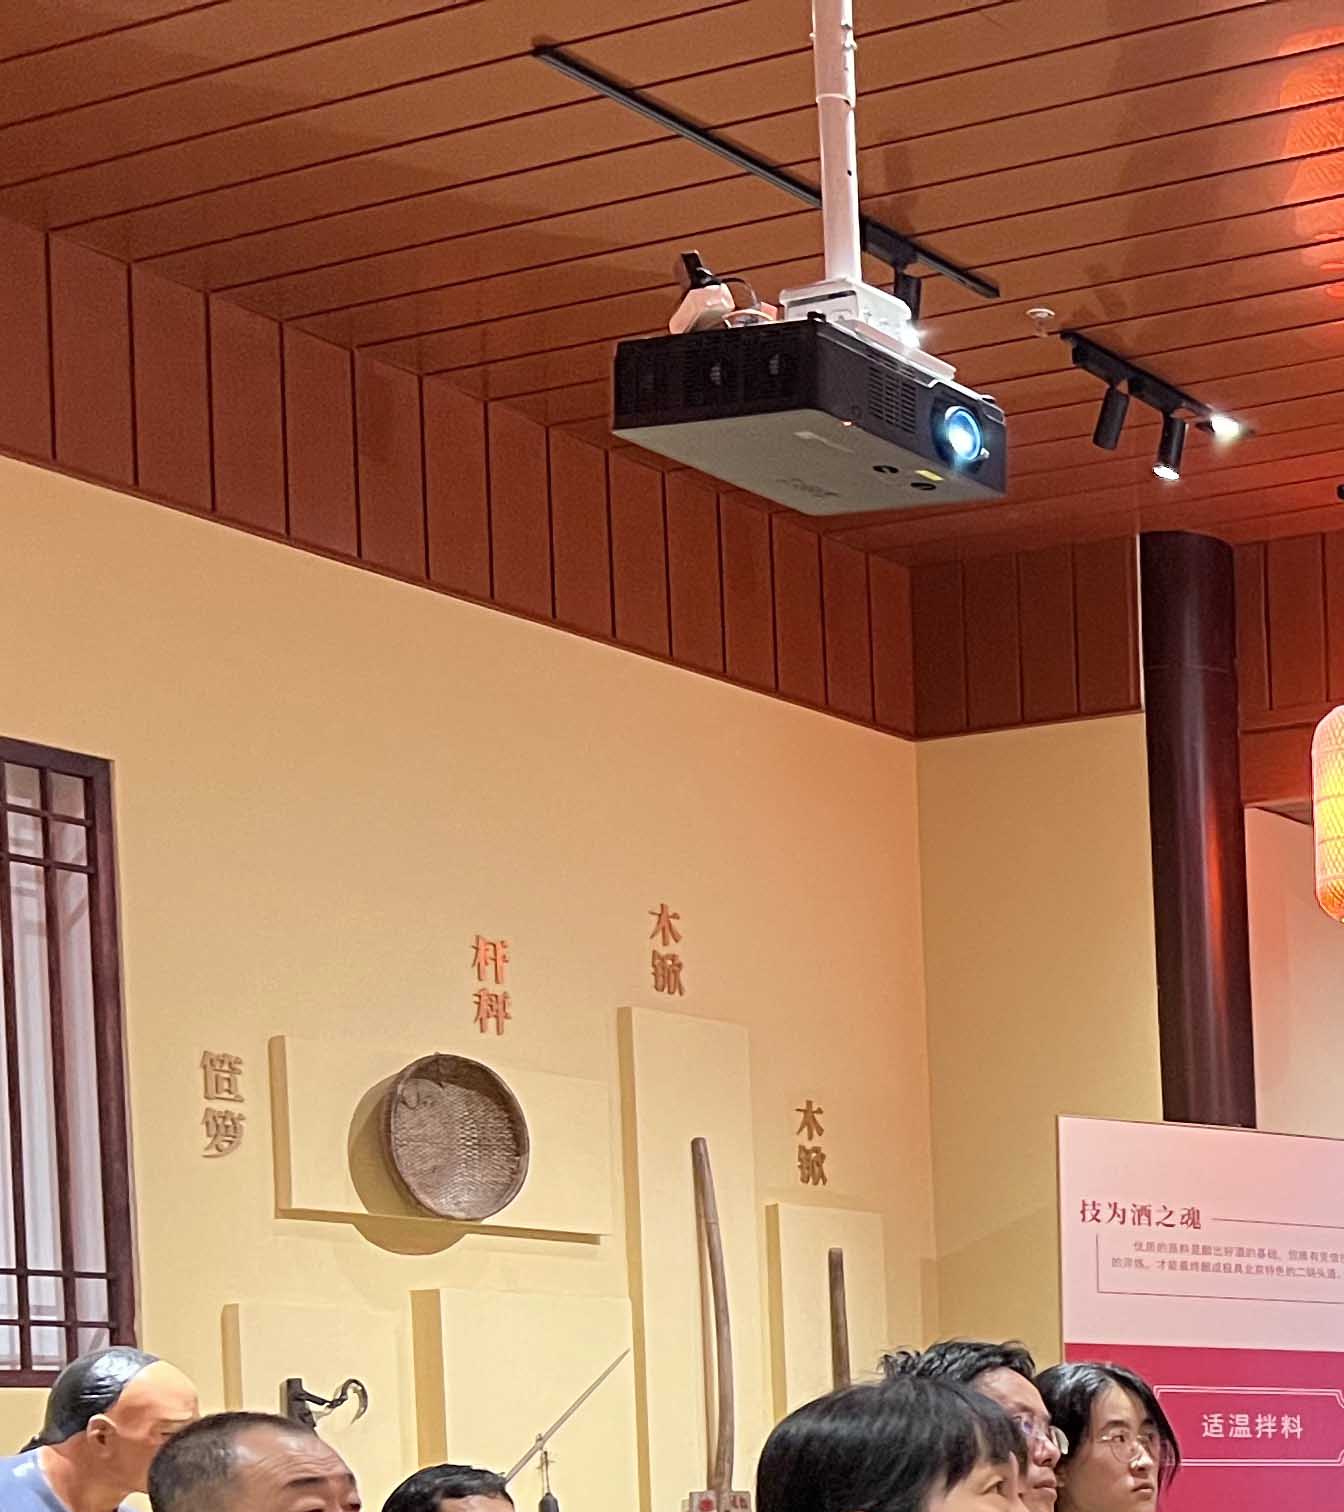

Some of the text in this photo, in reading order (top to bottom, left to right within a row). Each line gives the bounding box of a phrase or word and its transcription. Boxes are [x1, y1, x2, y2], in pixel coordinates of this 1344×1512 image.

[1079, 1199, 1202, 1230] 技为酒之魂
[1202, 1414, 1304, 1440] 适温拌料
